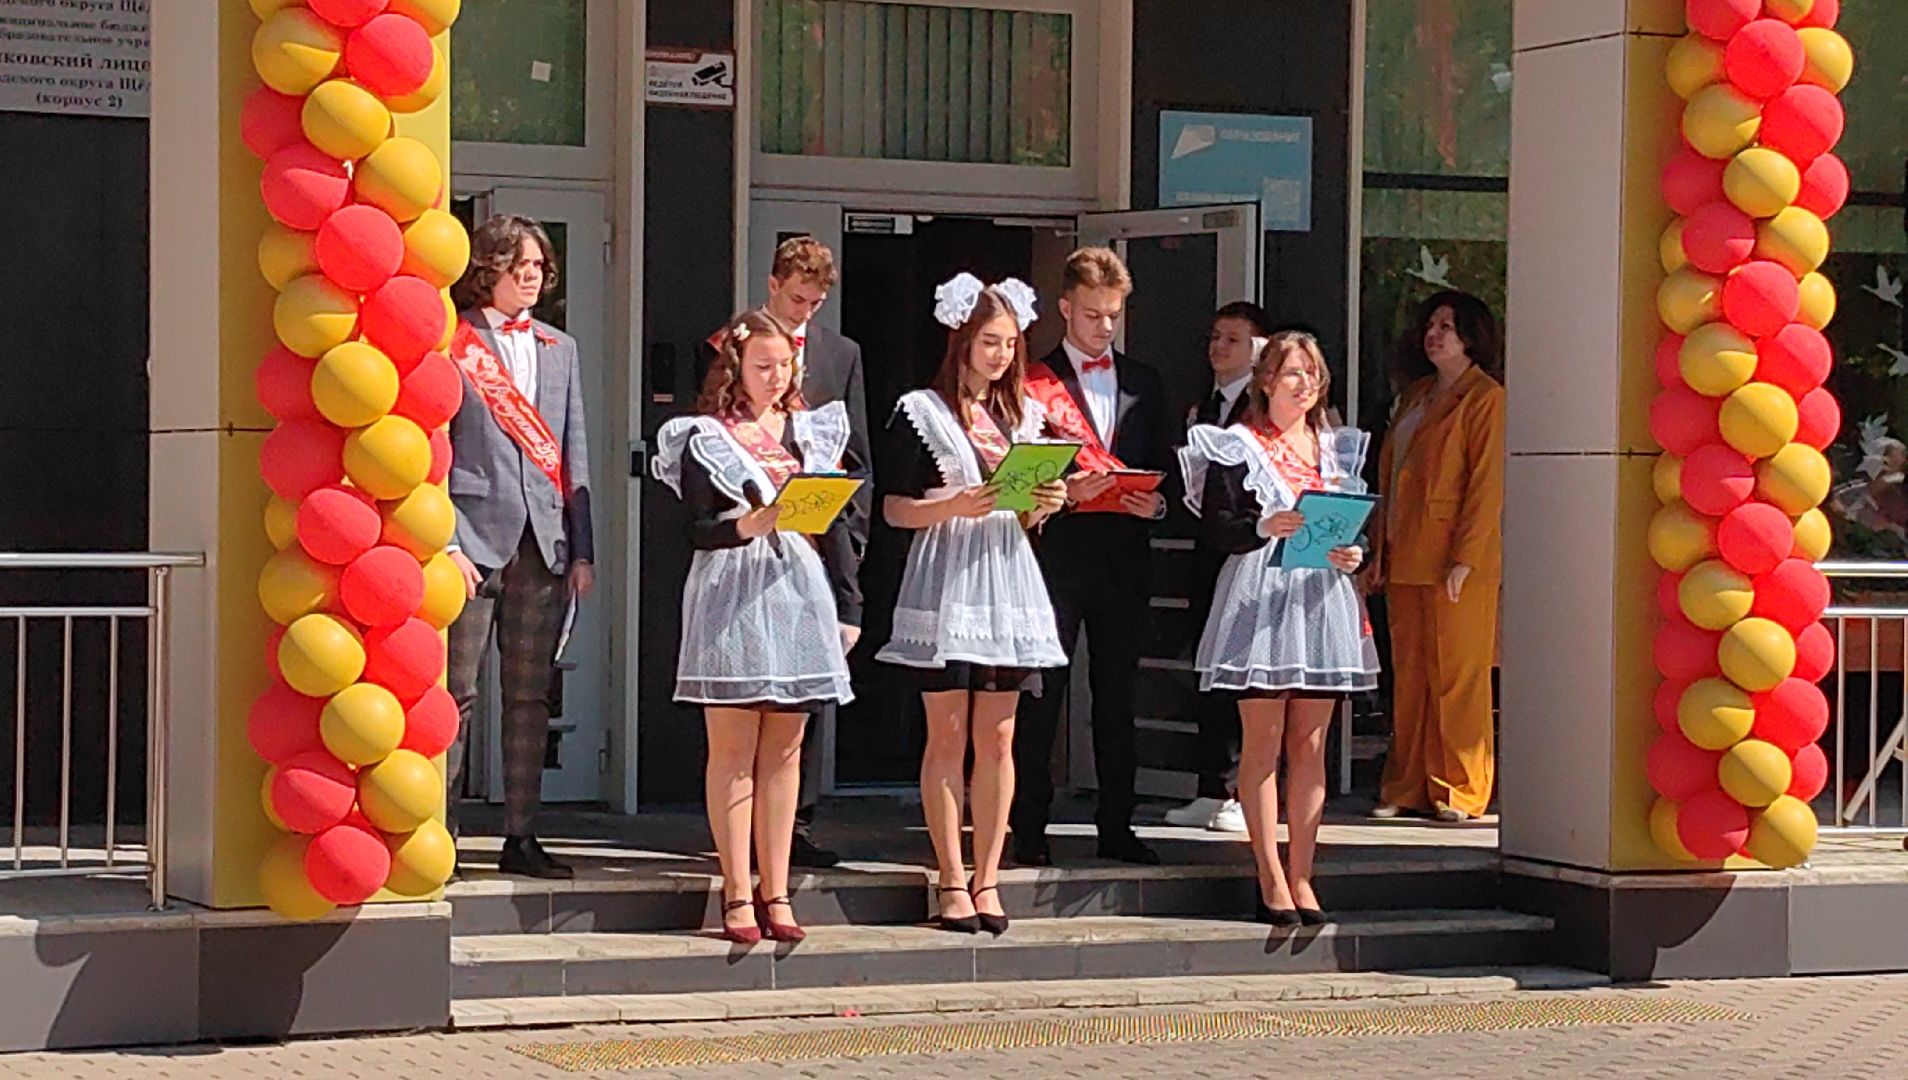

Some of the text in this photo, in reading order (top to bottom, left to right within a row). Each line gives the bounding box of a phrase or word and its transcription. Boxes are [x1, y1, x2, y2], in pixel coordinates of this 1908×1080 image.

[59, 79, 114, 90] округа
[36, 91, 123, 109] (корпус 2)
